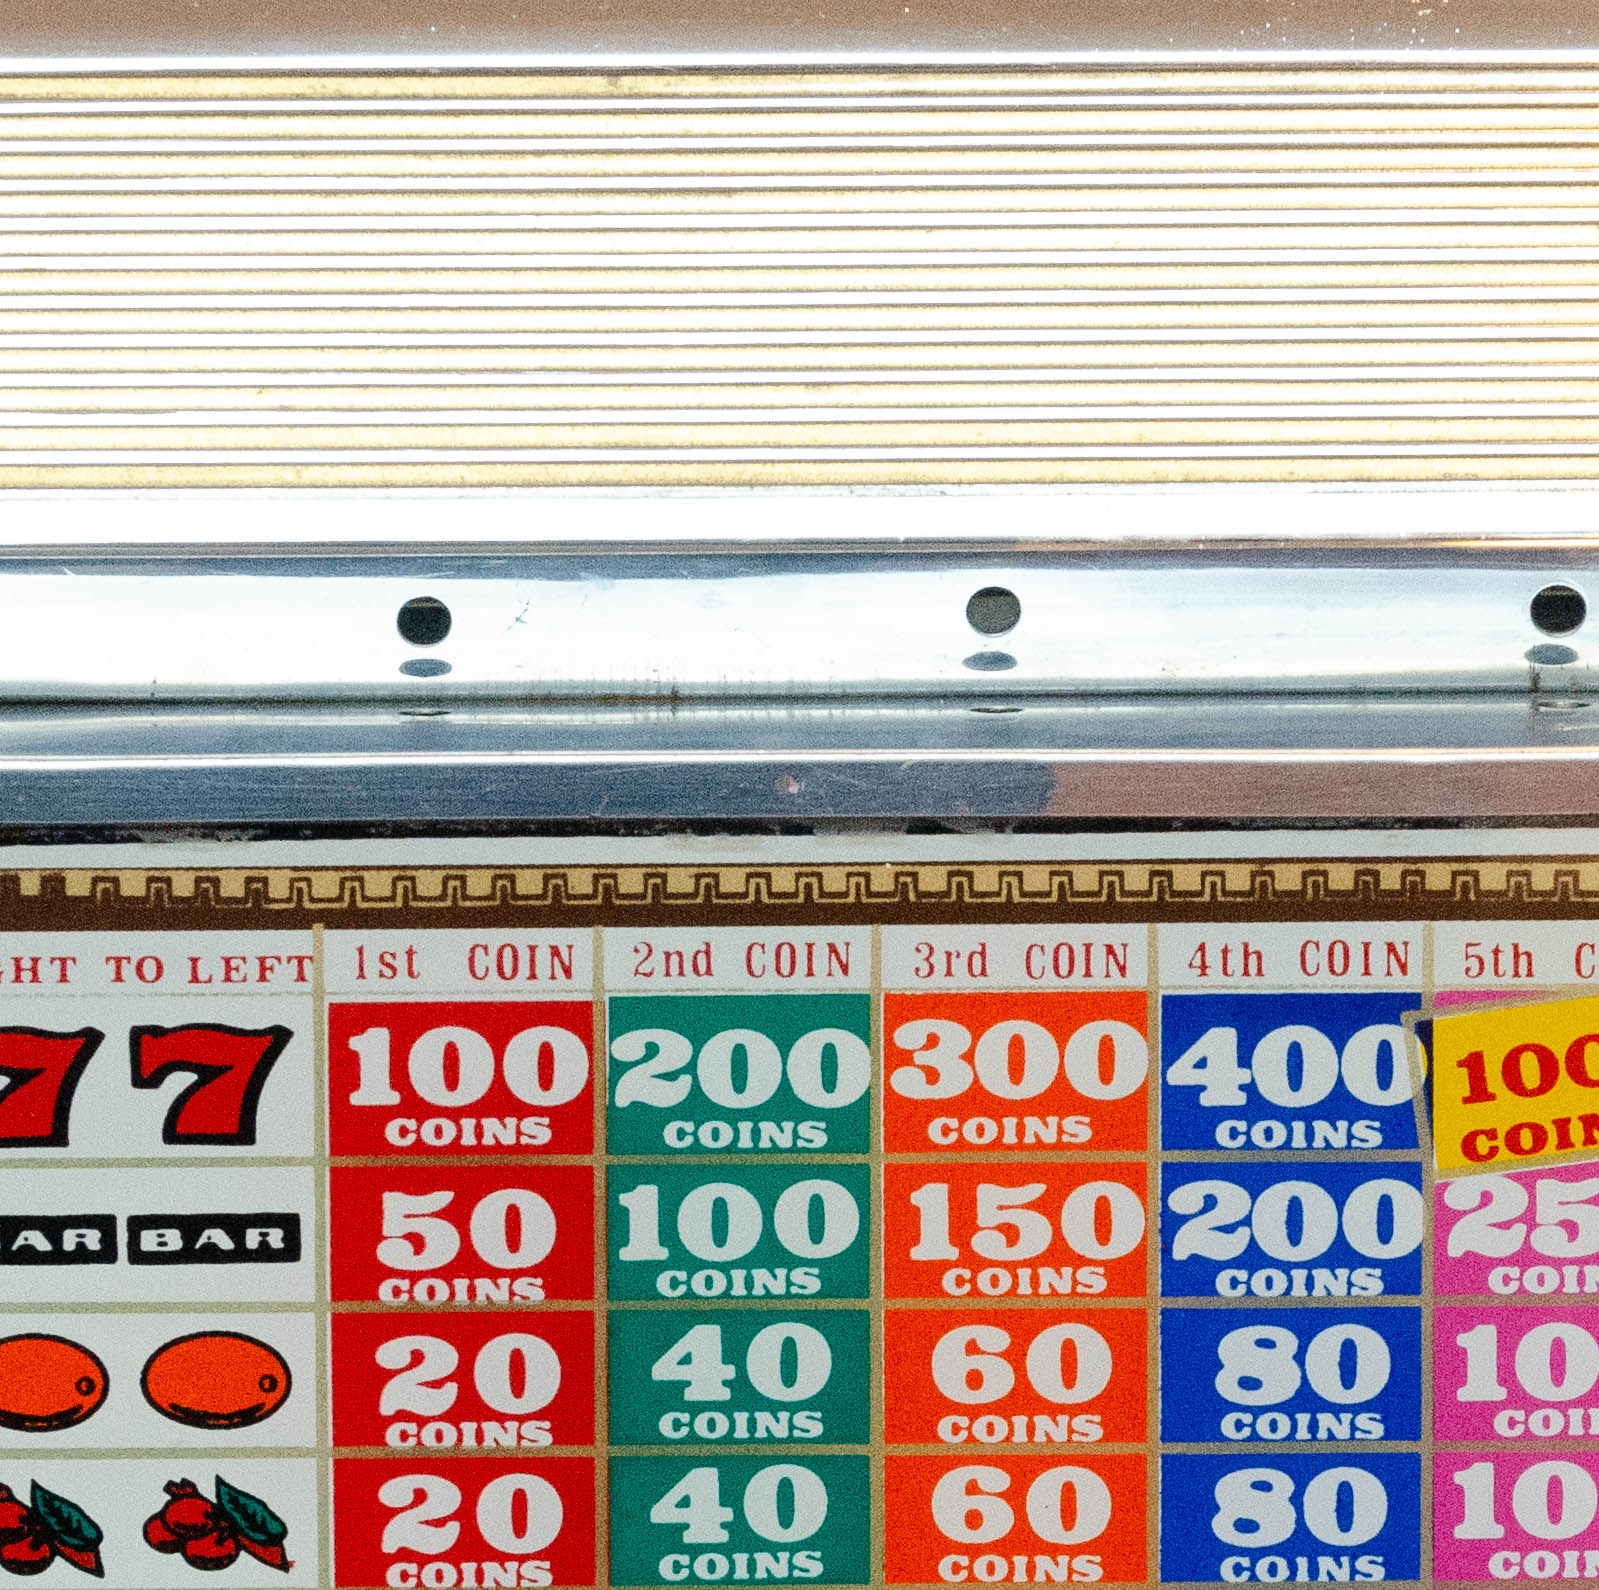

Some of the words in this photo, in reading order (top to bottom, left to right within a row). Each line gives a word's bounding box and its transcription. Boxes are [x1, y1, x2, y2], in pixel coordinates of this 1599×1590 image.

[107, 955, 164, 984] TO
[187, 954, 314, 984] LEFT
[355, 945, 419, 981] 1st
[468, 943, 575, 981] COIN
[633, 941, 714, 978] 2nd
[745, 941, 852, 978] COIN
[914, 941, 988, 978] 3rd
[1025, 942, 1129, 979] COIN
[1188, 941, 1264, 977] 4th
[1300, 940, 1411, 977] COIN
[1463, 941, 1535, 979] 5th
[350, 1027, 588, 1106] 100
[611, 1029, 872, 1107] 200
[891, 1020, 1149, 1099] 300
[1167, 1025, 1425, 1106] 400
[129, 1022, 295, 1147] 7
[387, 1117, 550, 1147] COINS
[665, 1121, 826, 1149] COINS
[930, 1117, 1090, 1145] COINS
[1217, 1120, 1381, 1150] COINS
[378, 1190, 555, 1270] 50
[620, 1180, 858, 1260] 100
[912, 1182, 1144, 1259] 150
[1169, 1180, 1426, 1261] 200
[140, 1227, 285, 1253] BAR
[380, 1277, 544, 1305] COINS
[658, 1268, 820, 1298] COINS
[944, 1267, 1105, 1296] COINS
[1217, 1268, 1382, 1300] COINS
[377, 1334, 560, 1415] 20
[653, 1324, 830, 1400] 40
[933, 1324, 1111, 1402] 60
[1216, 1325, 1389, 1405] 80
[387, 1421, 552, 1449] COINS
[660, 1411, 822, 1439] COINS
[939, 1415, 1101, 1445] COINS
[1222, 1413, 1382, 1441] COINS
[380, 1474, 562, 1553] 20
[652, 1465, 827, 1542] 40
[933, 1467, 1110, 1543] 60
[1213, 1468, 1386, 1547] 80
[388, 1560, 551, 1590] COINS
[660, 1551, 822, 1581] COINS
[940, 1555, 1101, 1584] COINS
[1222, 1556, 1383, 1585] COINS
